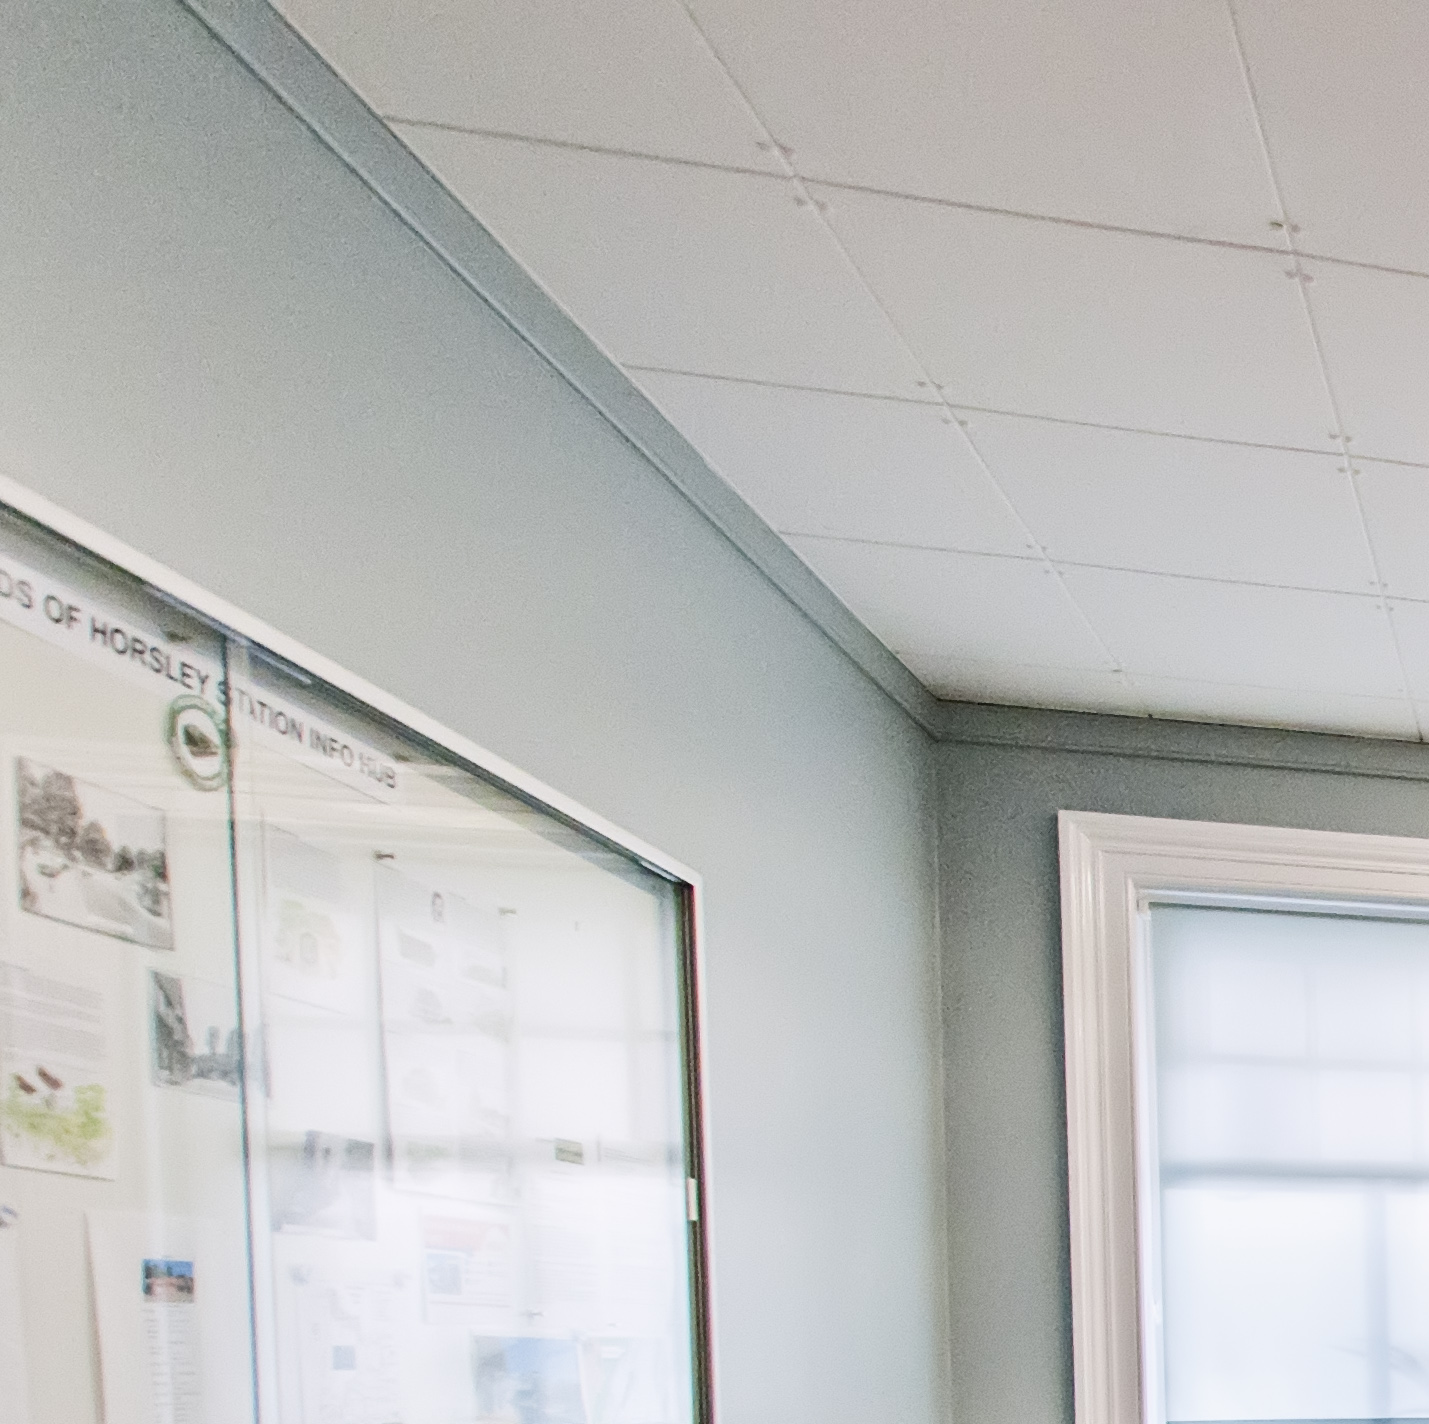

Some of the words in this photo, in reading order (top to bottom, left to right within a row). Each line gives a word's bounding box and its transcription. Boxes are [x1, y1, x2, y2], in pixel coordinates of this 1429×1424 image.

[43, 594, 82, 630] OF
[90, 616, 210, 695] HORSLEY
[309, 726, 354, 768] INFO
[358, 751, 397, 789] HUB
